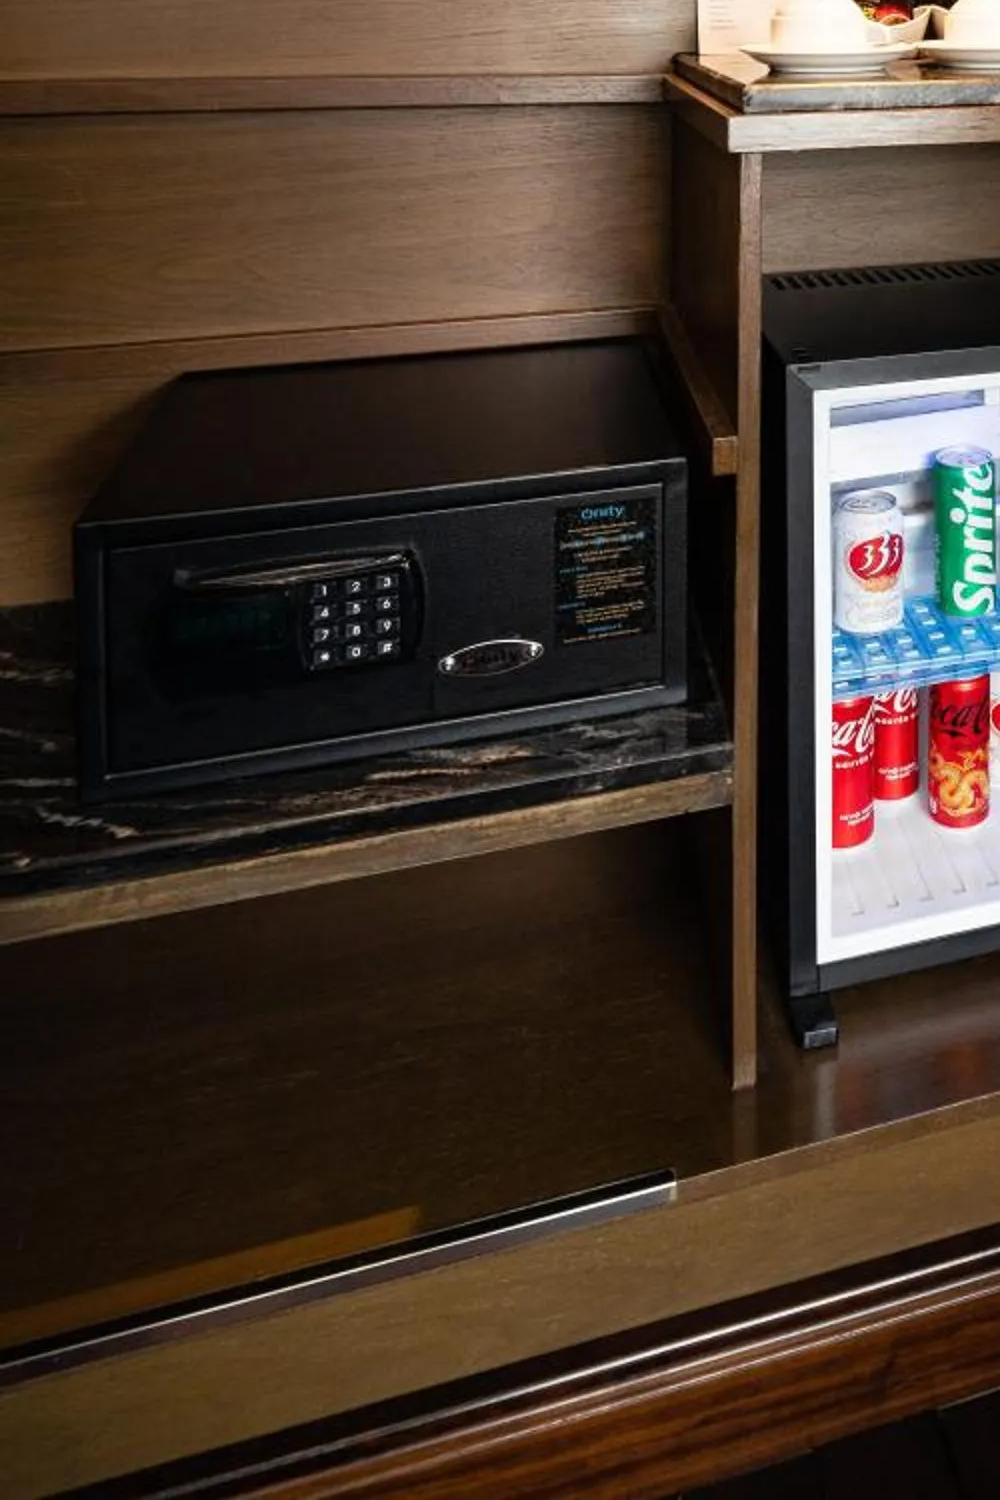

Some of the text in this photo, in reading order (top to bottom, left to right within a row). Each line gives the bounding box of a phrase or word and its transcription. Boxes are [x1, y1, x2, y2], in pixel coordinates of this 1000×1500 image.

[949, 462, 996, 613] Sprite
[859, 532, 900, 577] 333
[321, 576, 391, 596] 1 2 3
[320, 599, 391, 617] 4 5 6
[321, 619, 392, 640] 7 8 9
[351, 646, 361, 657] 0
